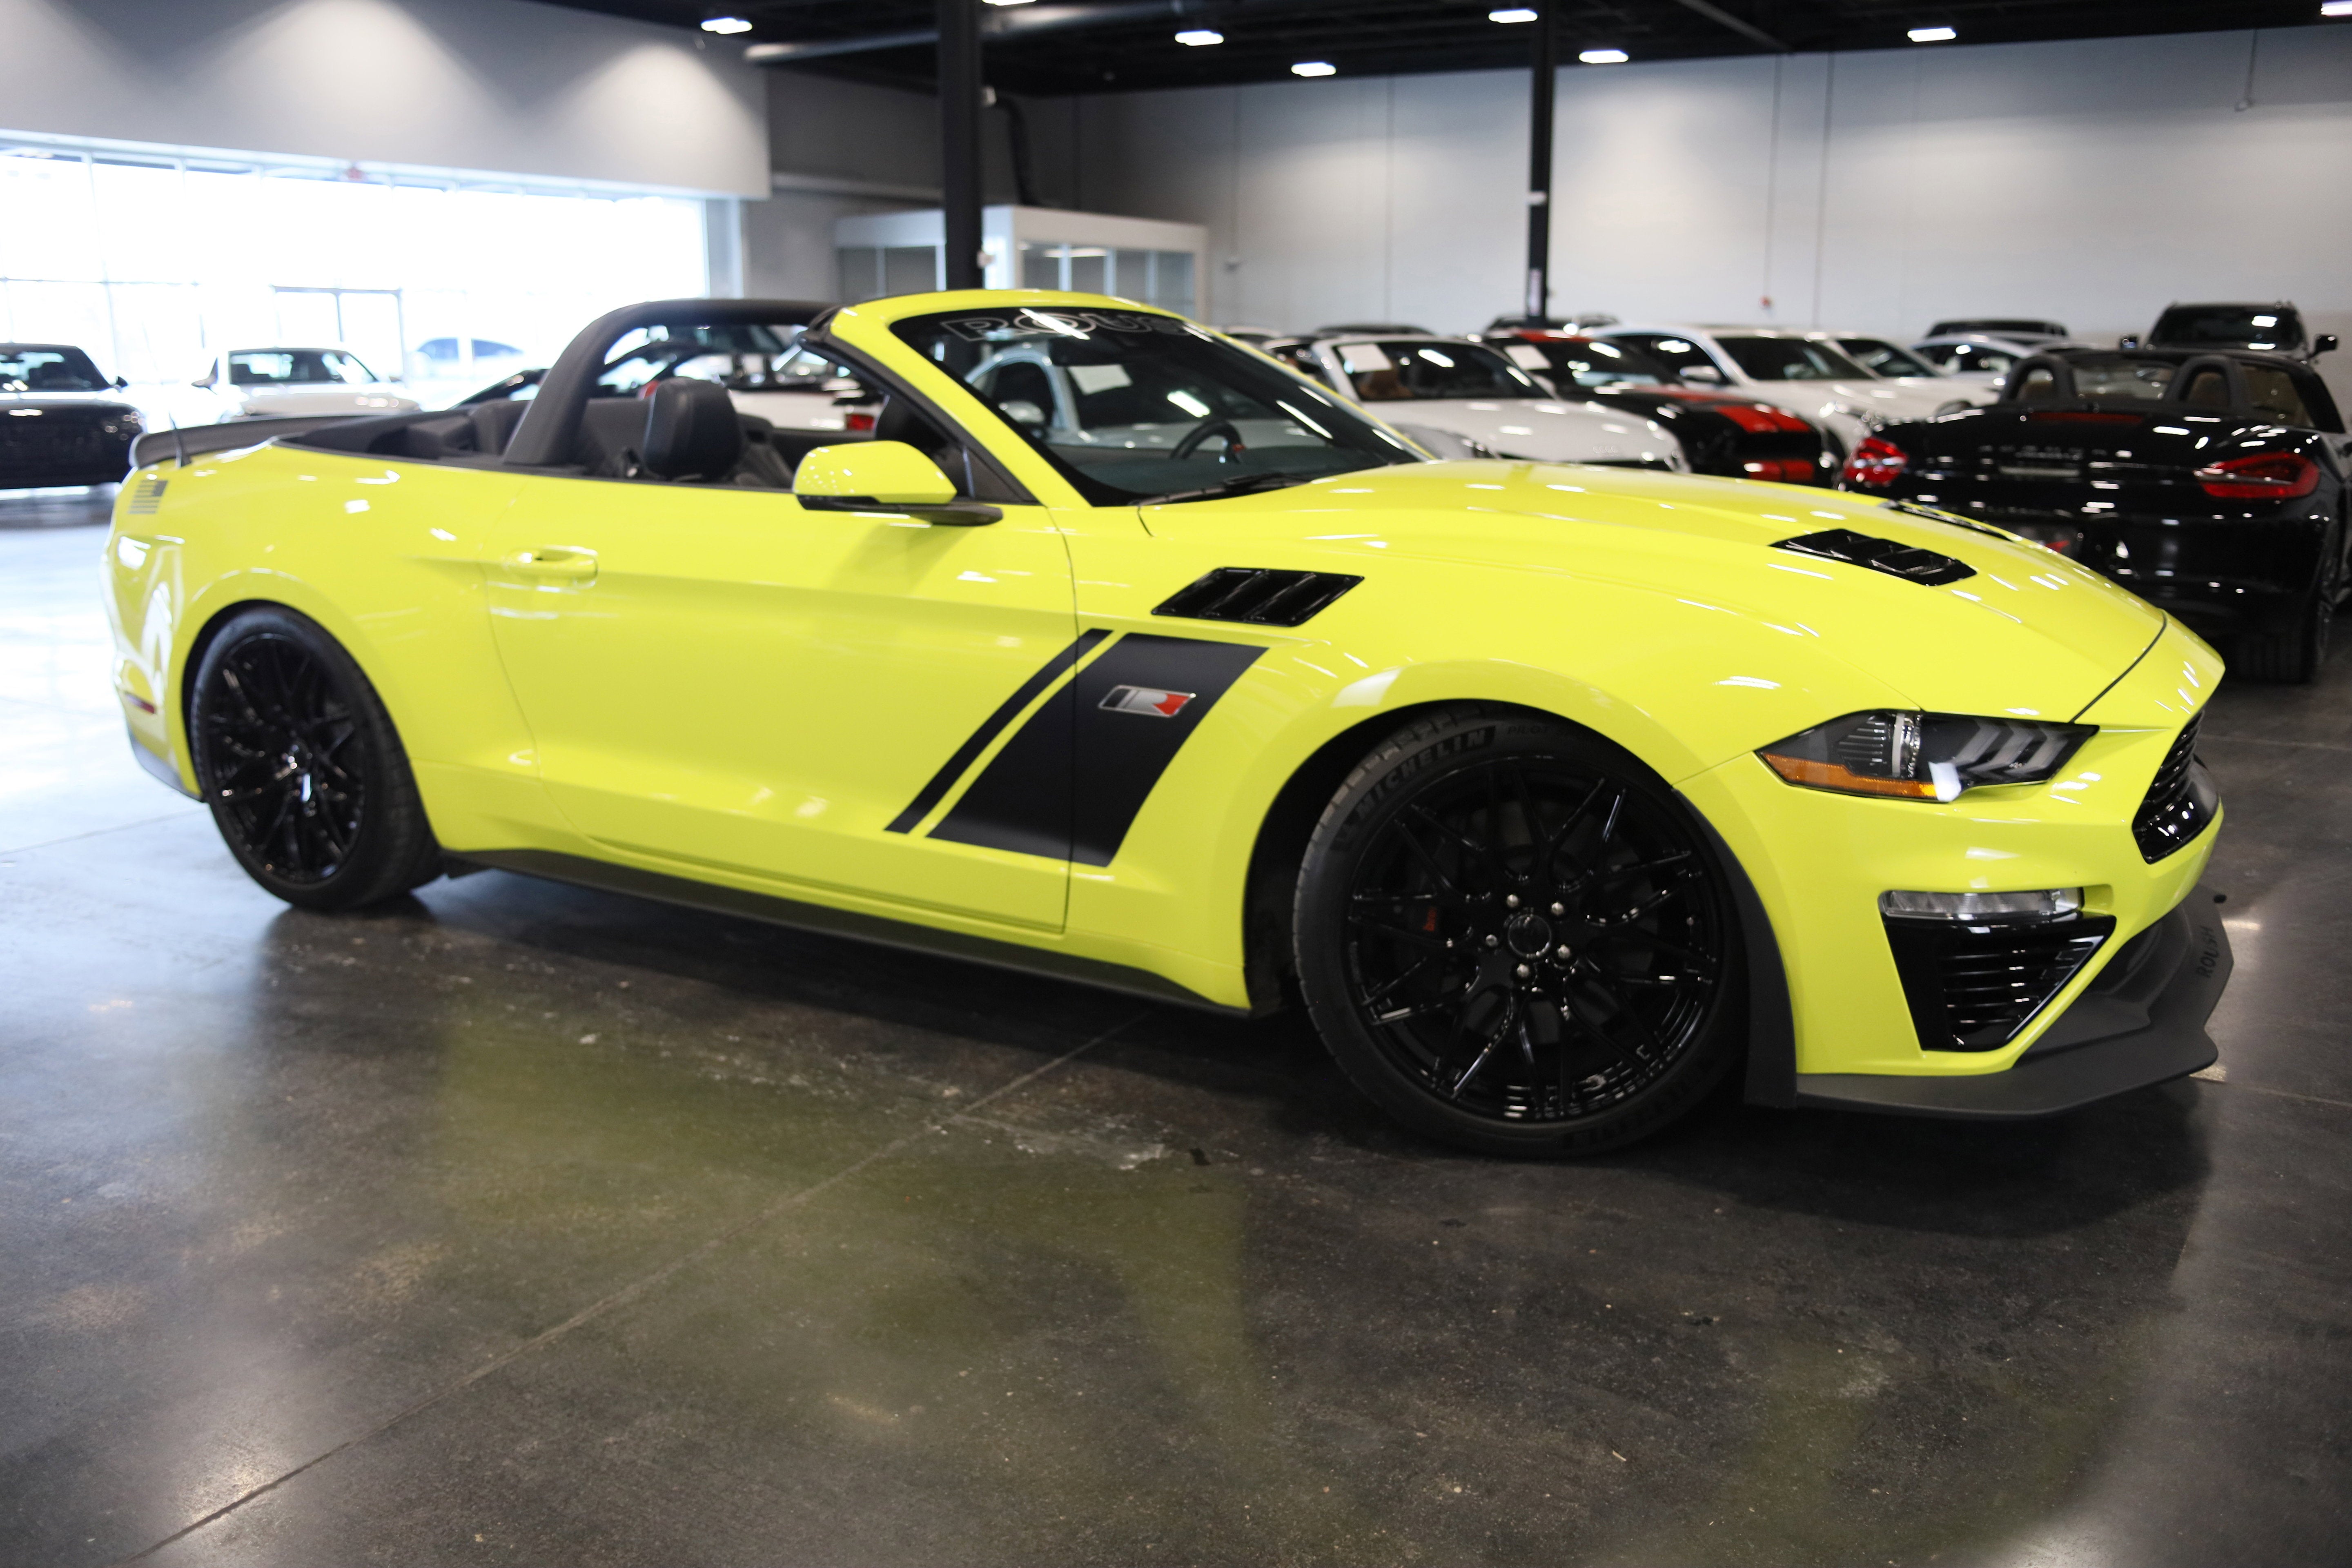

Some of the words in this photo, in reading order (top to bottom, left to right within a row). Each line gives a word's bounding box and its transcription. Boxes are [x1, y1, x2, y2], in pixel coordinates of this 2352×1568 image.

[940, 310, 1193, 341] ROUS
[1355, 728, 1486, 819] MICHELIN
[1507, 725, 1550, 735] PILOT
[2194, 924, 2220, 978] ROUSH
